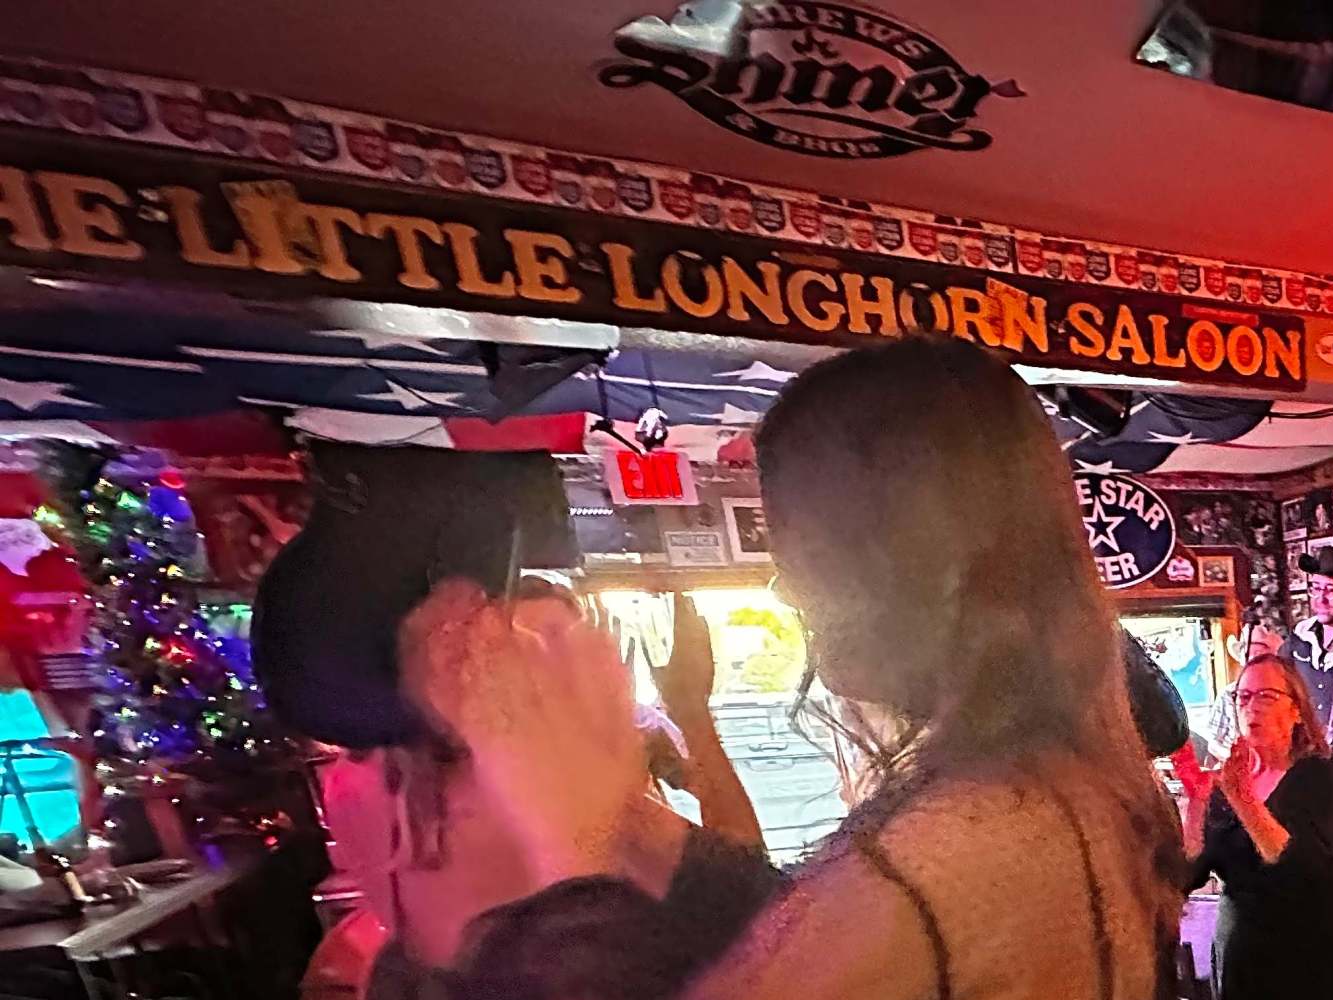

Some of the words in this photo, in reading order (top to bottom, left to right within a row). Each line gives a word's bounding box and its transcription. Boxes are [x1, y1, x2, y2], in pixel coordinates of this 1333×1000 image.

[0, 166, 146, 261] HE
[156, 179, 583, 304] LITTLE
[602, 243, 1049, 353] LONGHORN
[1068, 302, 1303, 382] SALOON
[1100, 479, 1165, 531] STAR
